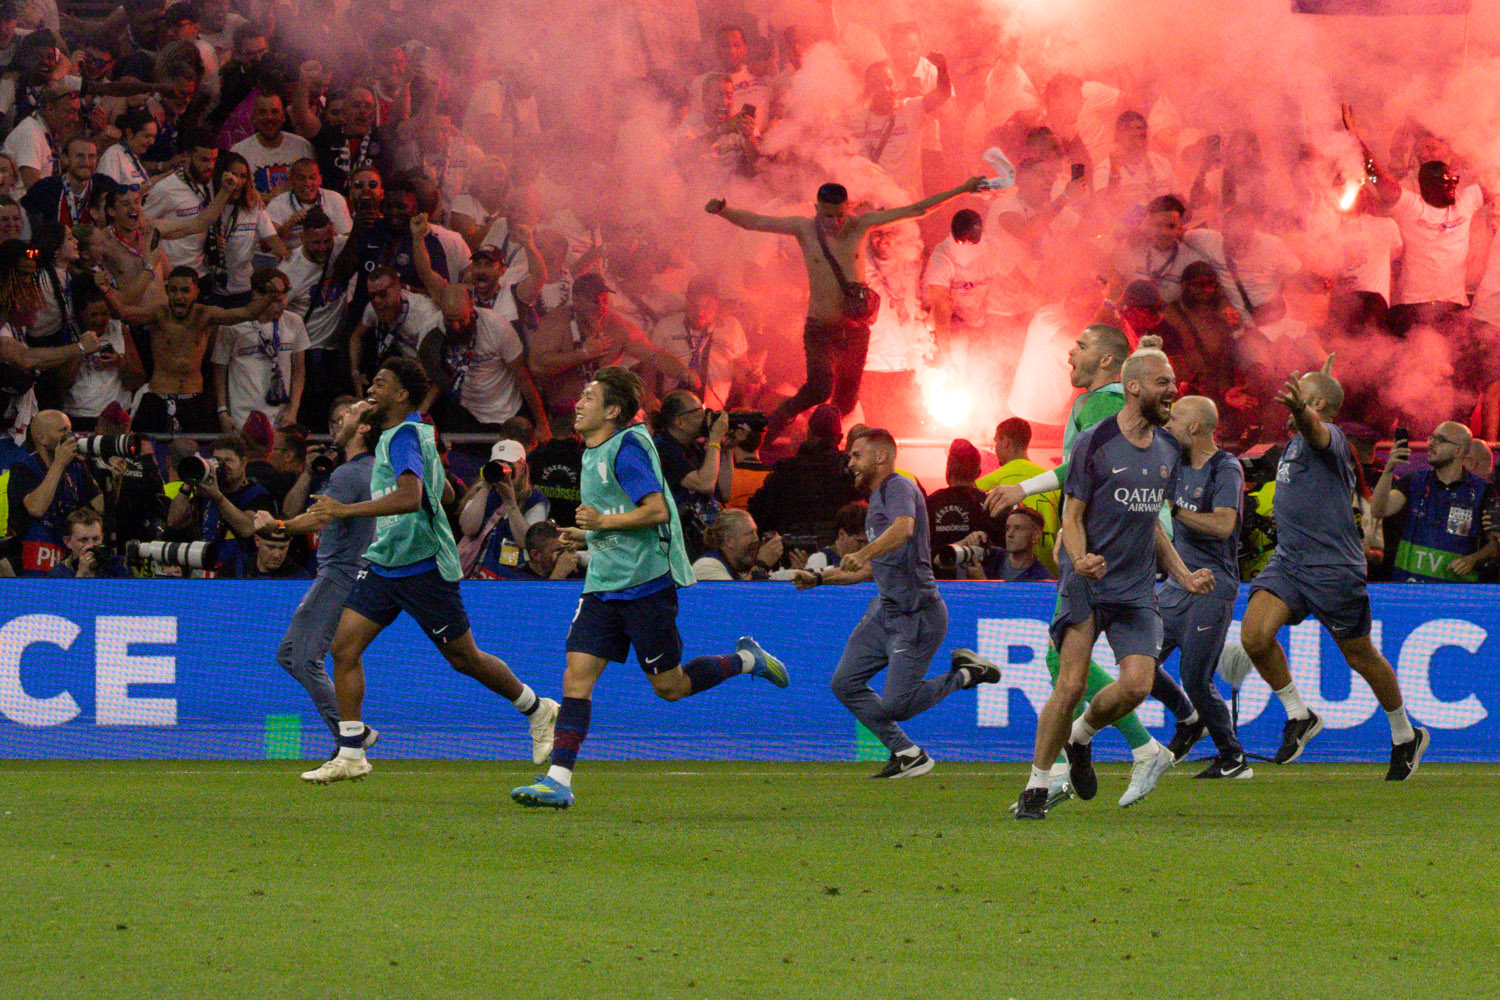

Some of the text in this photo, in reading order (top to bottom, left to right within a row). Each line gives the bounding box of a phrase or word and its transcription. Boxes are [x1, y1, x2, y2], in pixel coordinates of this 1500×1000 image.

[1114, 487, 1164, 505] QATAR
[1127, 502, 1162, 513] AIRWAYS
[1414, 550, 1445, 573] TV
